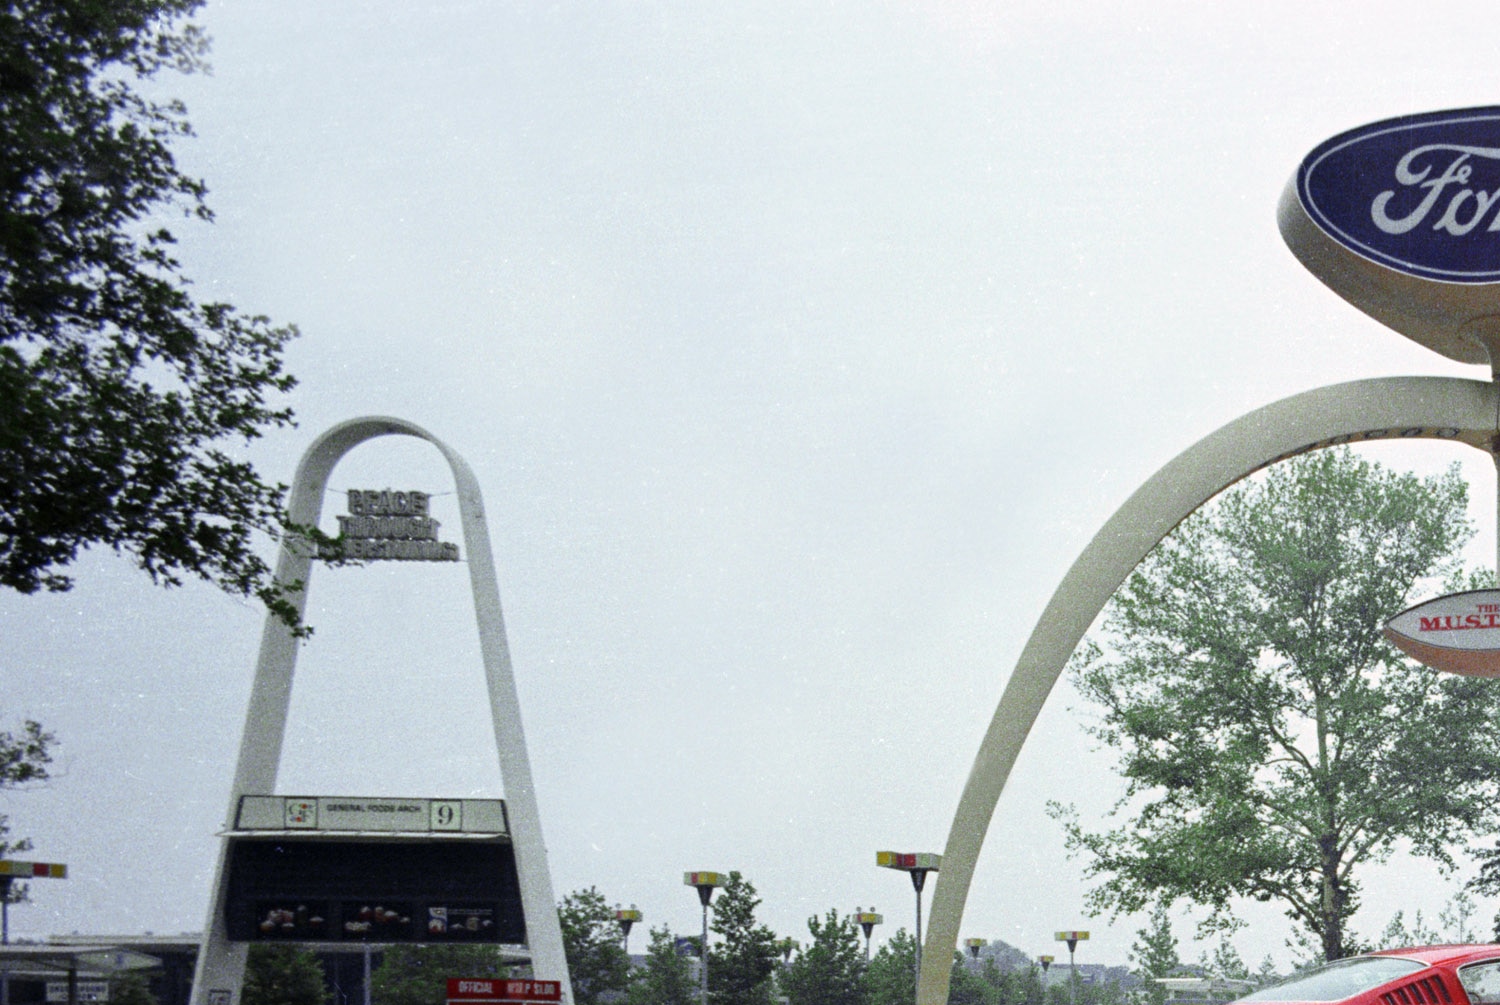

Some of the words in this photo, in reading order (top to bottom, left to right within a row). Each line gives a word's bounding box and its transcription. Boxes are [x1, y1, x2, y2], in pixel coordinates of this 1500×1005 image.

[347, 489, 431, 516] PEACE
[1476, 604, 1500, 613] THE
[327, 804, 365, 812] GENERAL
[367, 804, 394, 812] FOODS
[397, 805, 421, 813] ARCH
[438, 805, 454, 825] 9
[458, 981, 493, 994] OFFICIAL
